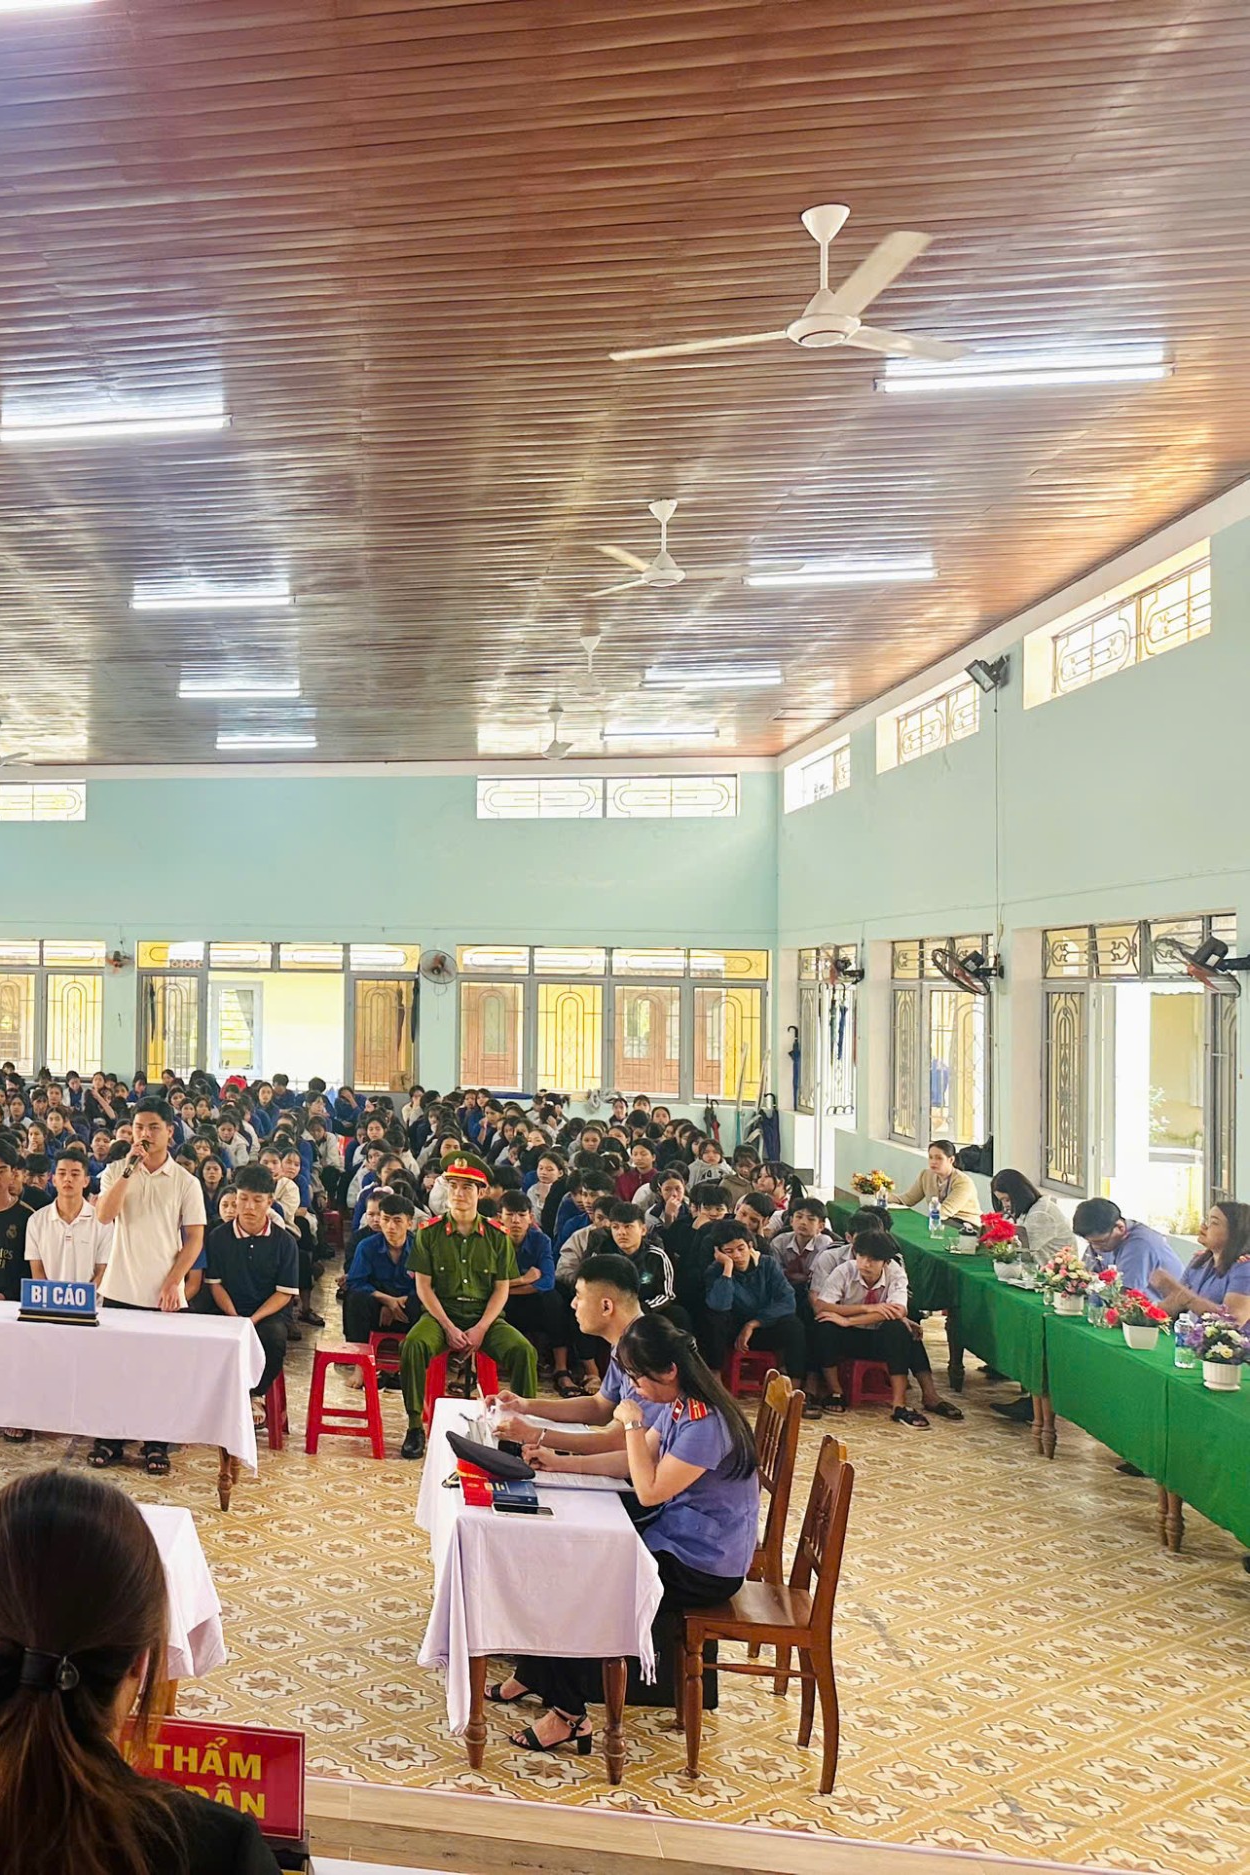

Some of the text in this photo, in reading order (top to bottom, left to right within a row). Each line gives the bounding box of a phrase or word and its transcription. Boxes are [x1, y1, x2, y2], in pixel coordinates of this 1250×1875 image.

[31, 1284, 87, 1308] BỊ CÁO
[148, 1736, 262, 1780] THẨM
